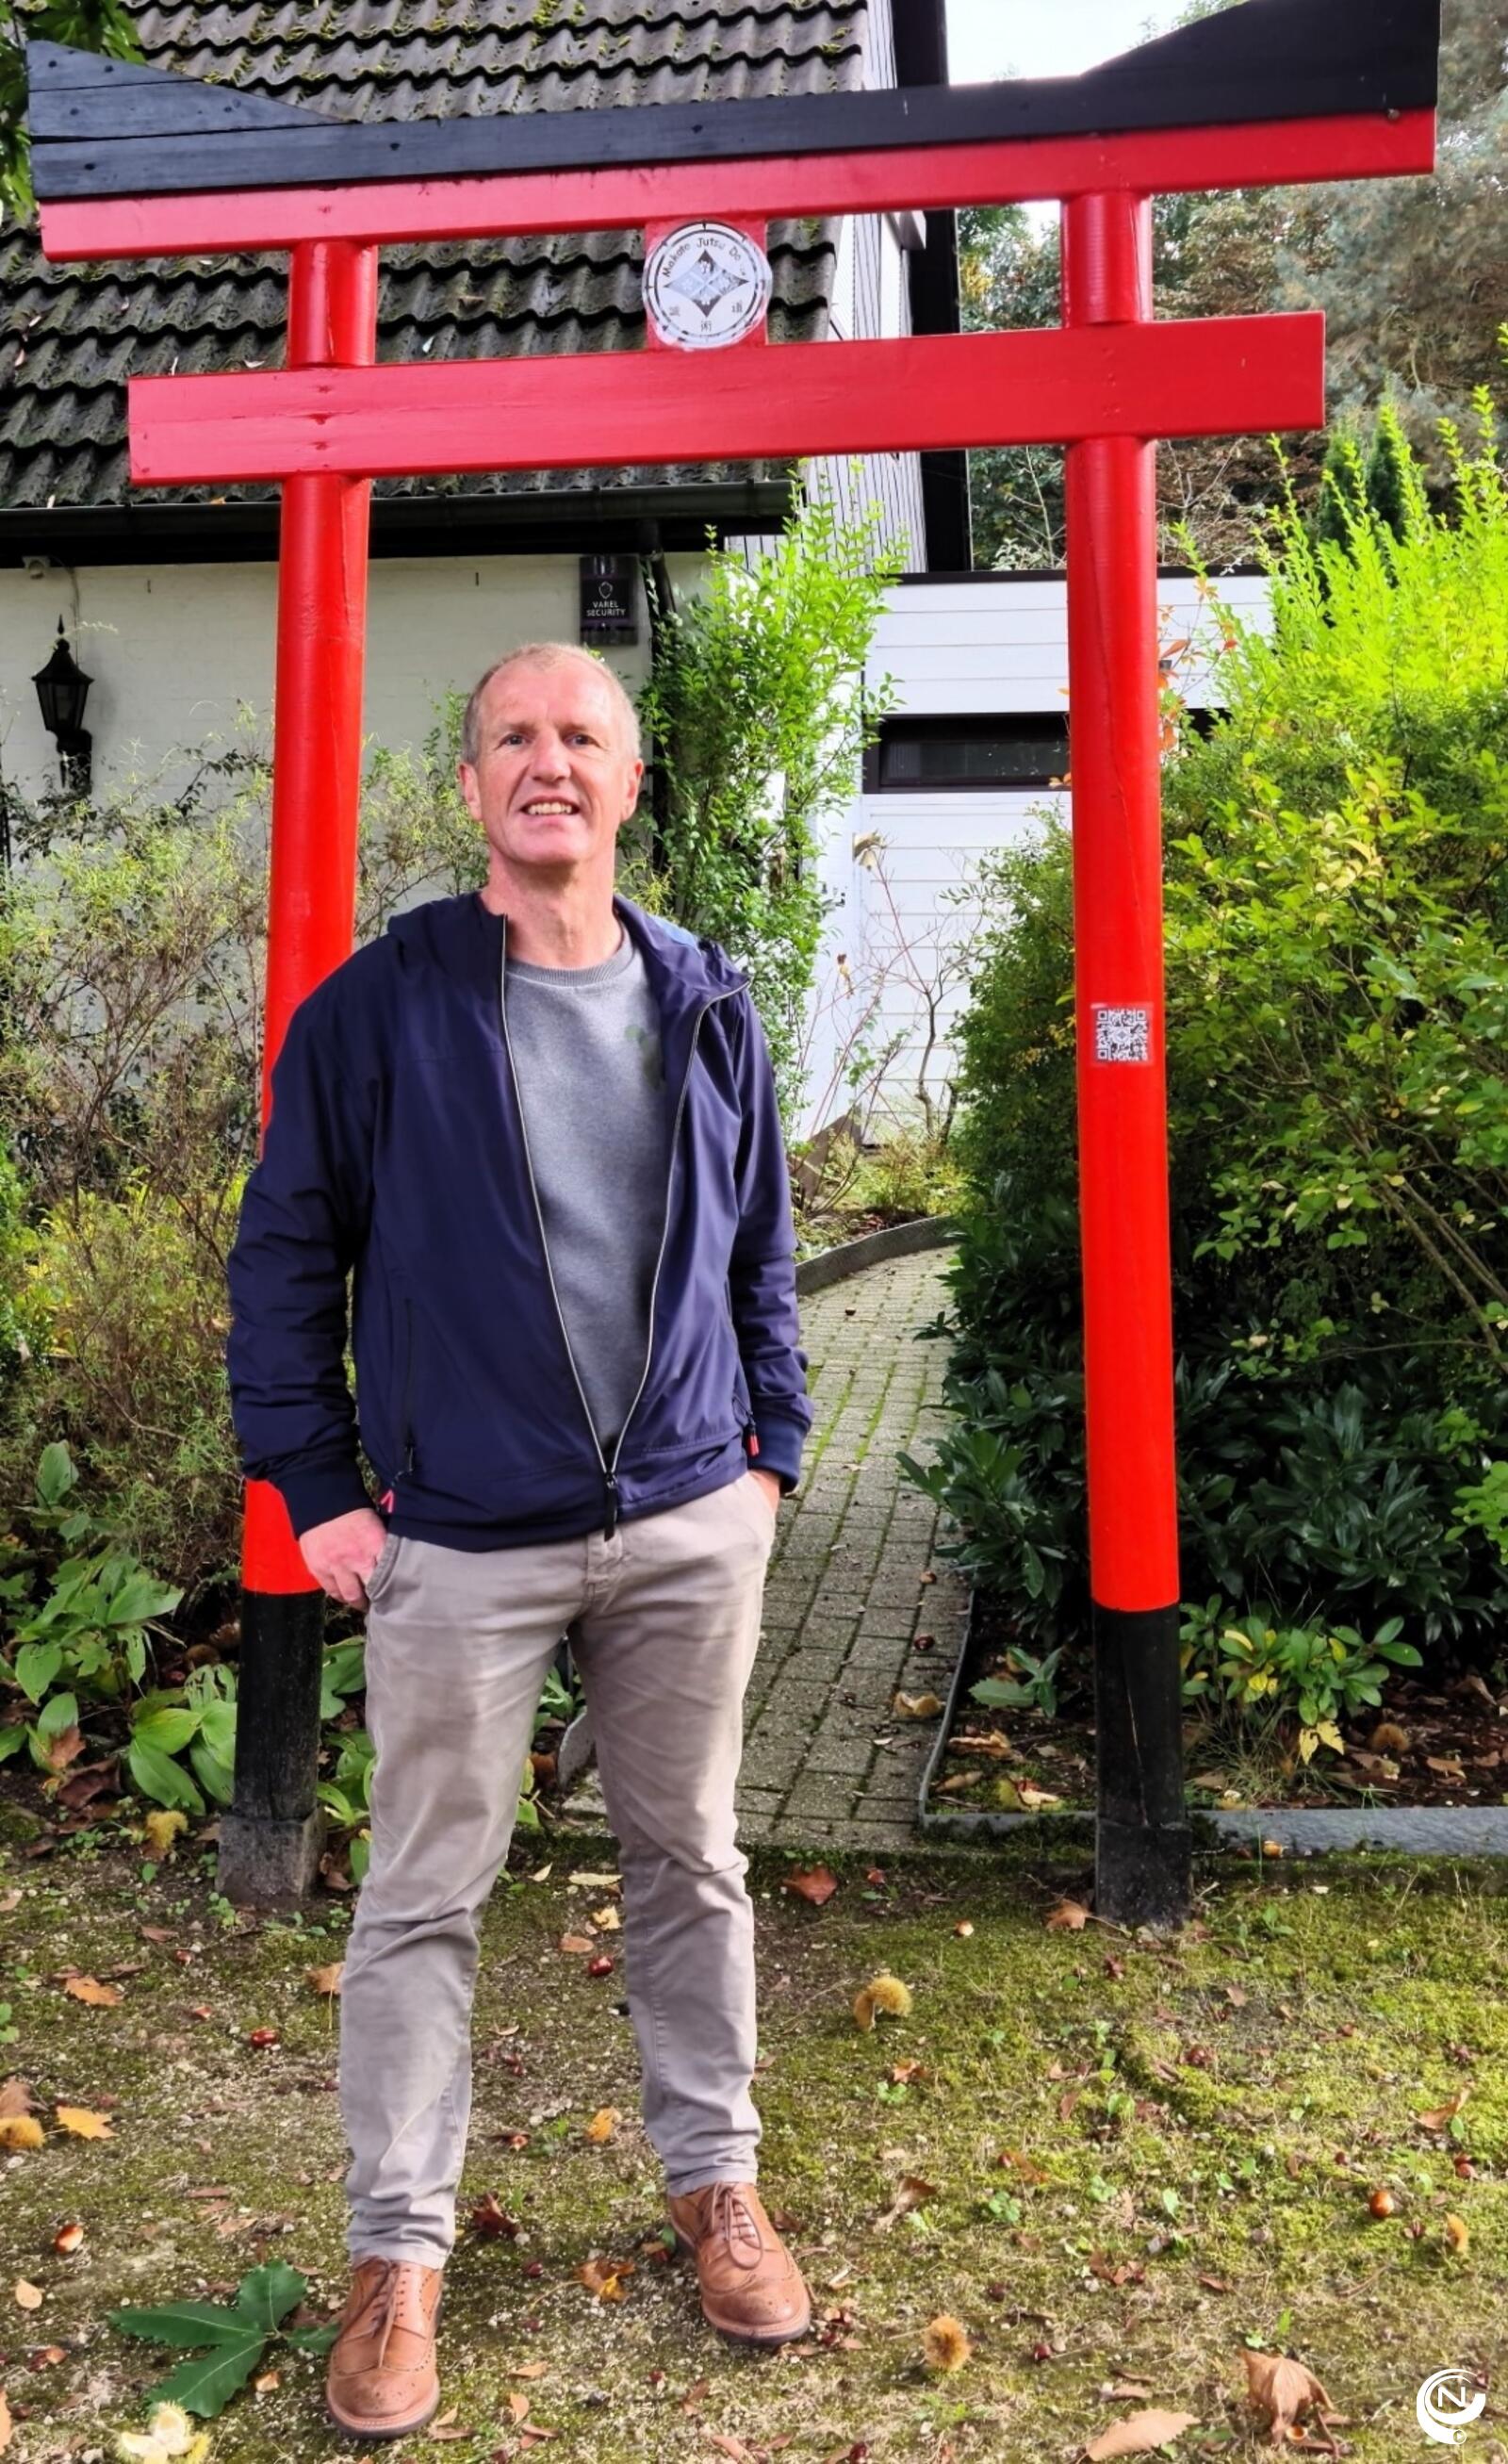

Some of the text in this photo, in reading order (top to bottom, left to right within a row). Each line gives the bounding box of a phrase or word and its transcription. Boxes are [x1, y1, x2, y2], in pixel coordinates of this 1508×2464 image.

[697, 238, 726, 250] Jutsu
[592, 600, 619, 609] VAREL
[586, 608, 626, 616] SECURITY
